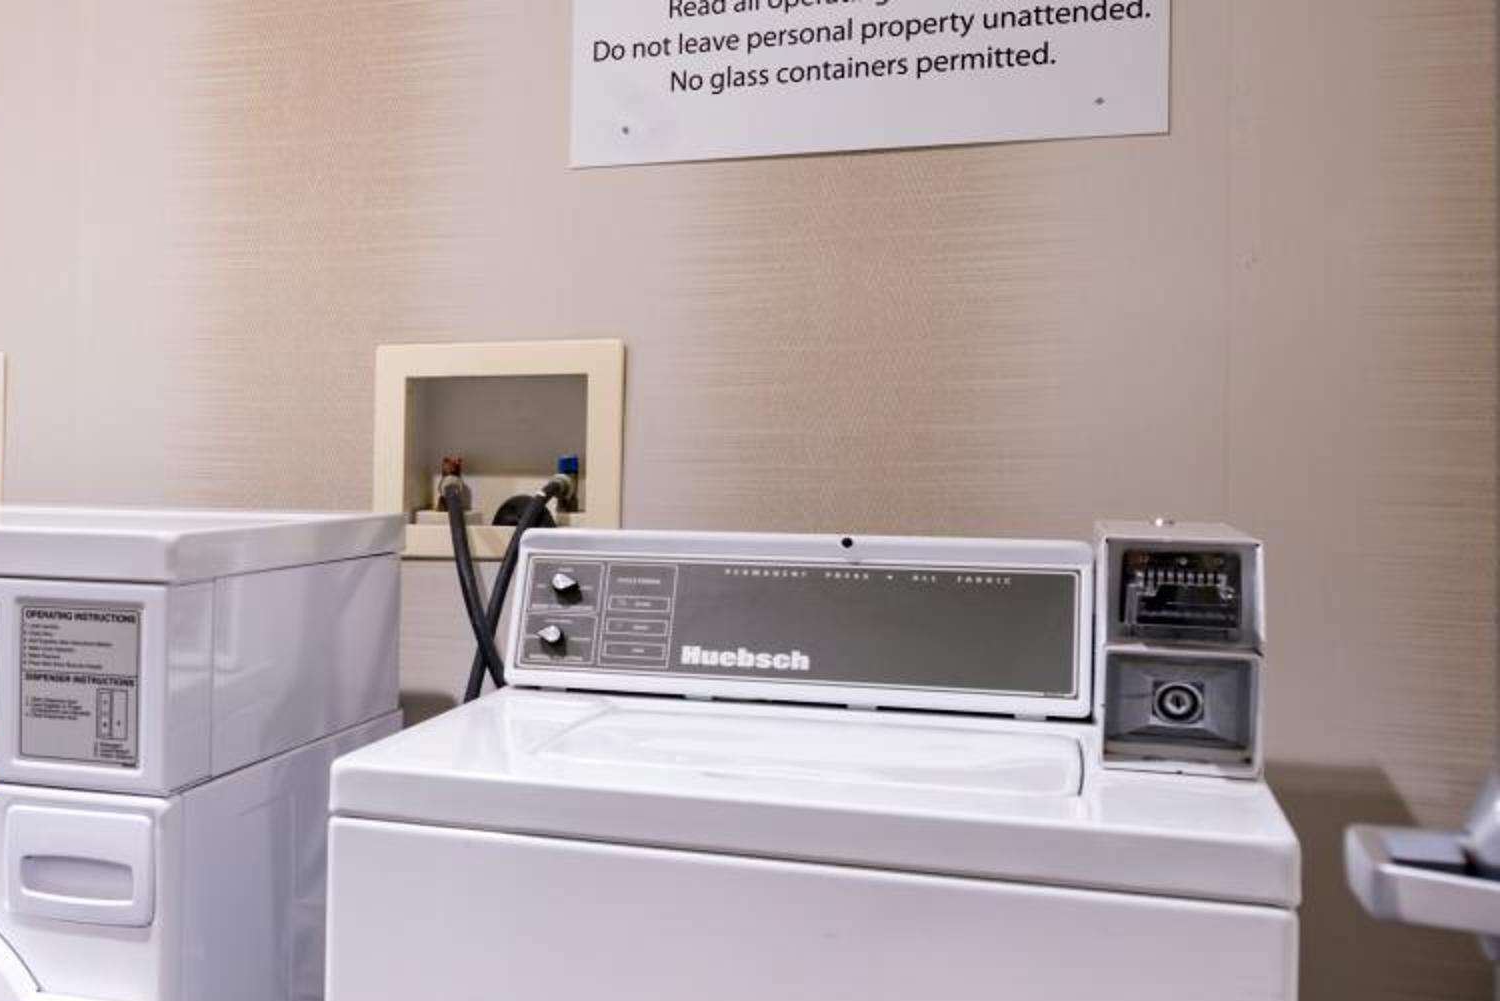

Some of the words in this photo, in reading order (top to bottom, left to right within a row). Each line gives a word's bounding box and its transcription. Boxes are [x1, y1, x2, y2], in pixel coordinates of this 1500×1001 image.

[668, 0, 726, 18] Read
[592, 41, 625, 62] Do
[632, 38, 671, 59] not
[678, 33, 740, 55] leave
[747, 18, 853, 54] personal
[861, 12, 975, 44] property
[982, 0, 1151, 30] unattended.
[670, 70, 703, 92] No
[710, 66, 770, 95] glass
[776, 57, 909, 85] containers
[916, 41, 1056, 78] permitted.
[25, 609, 73, 621] OPERATING
[74, 612, 136, 623] INSTRUCTIONS
[681, 645, 810, 671] Huebsch
[73, 676, 135, 687] INSTRUCTIONS
